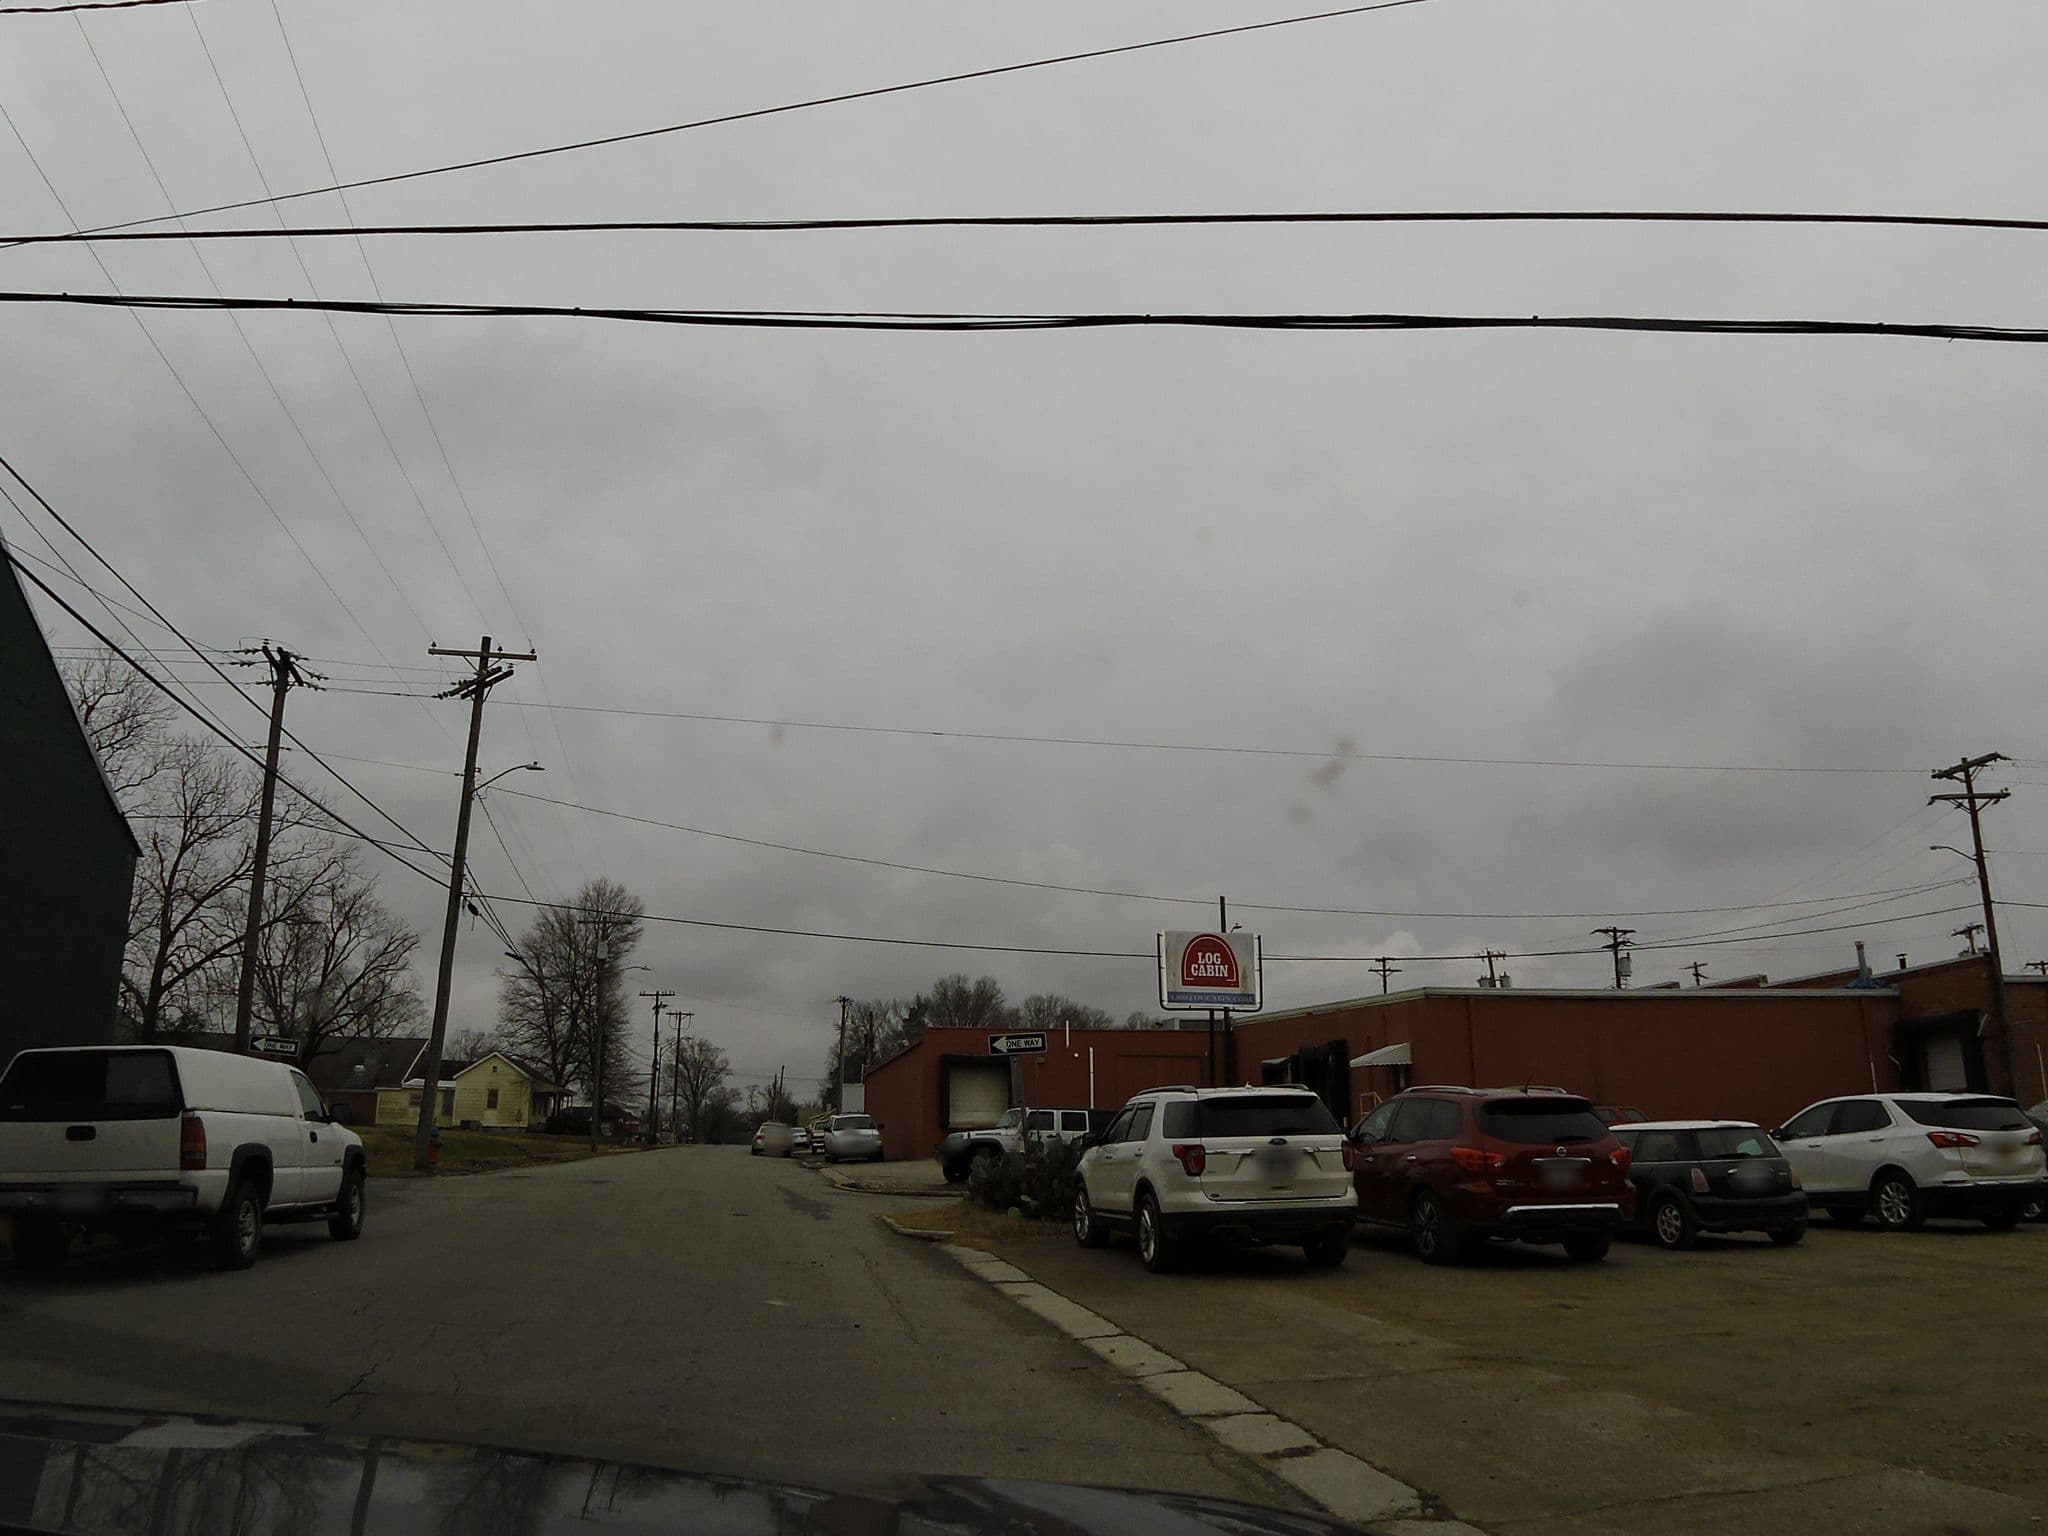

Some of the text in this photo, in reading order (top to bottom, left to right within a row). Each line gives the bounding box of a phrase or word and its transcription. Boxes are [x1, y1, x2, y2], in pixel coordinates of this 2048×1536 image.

[1197, 952, 1222, 964] LOG
[1191, 963, 1229, 977] CABIN
[1006, 1038, 1040, 1048] ONE WAY
